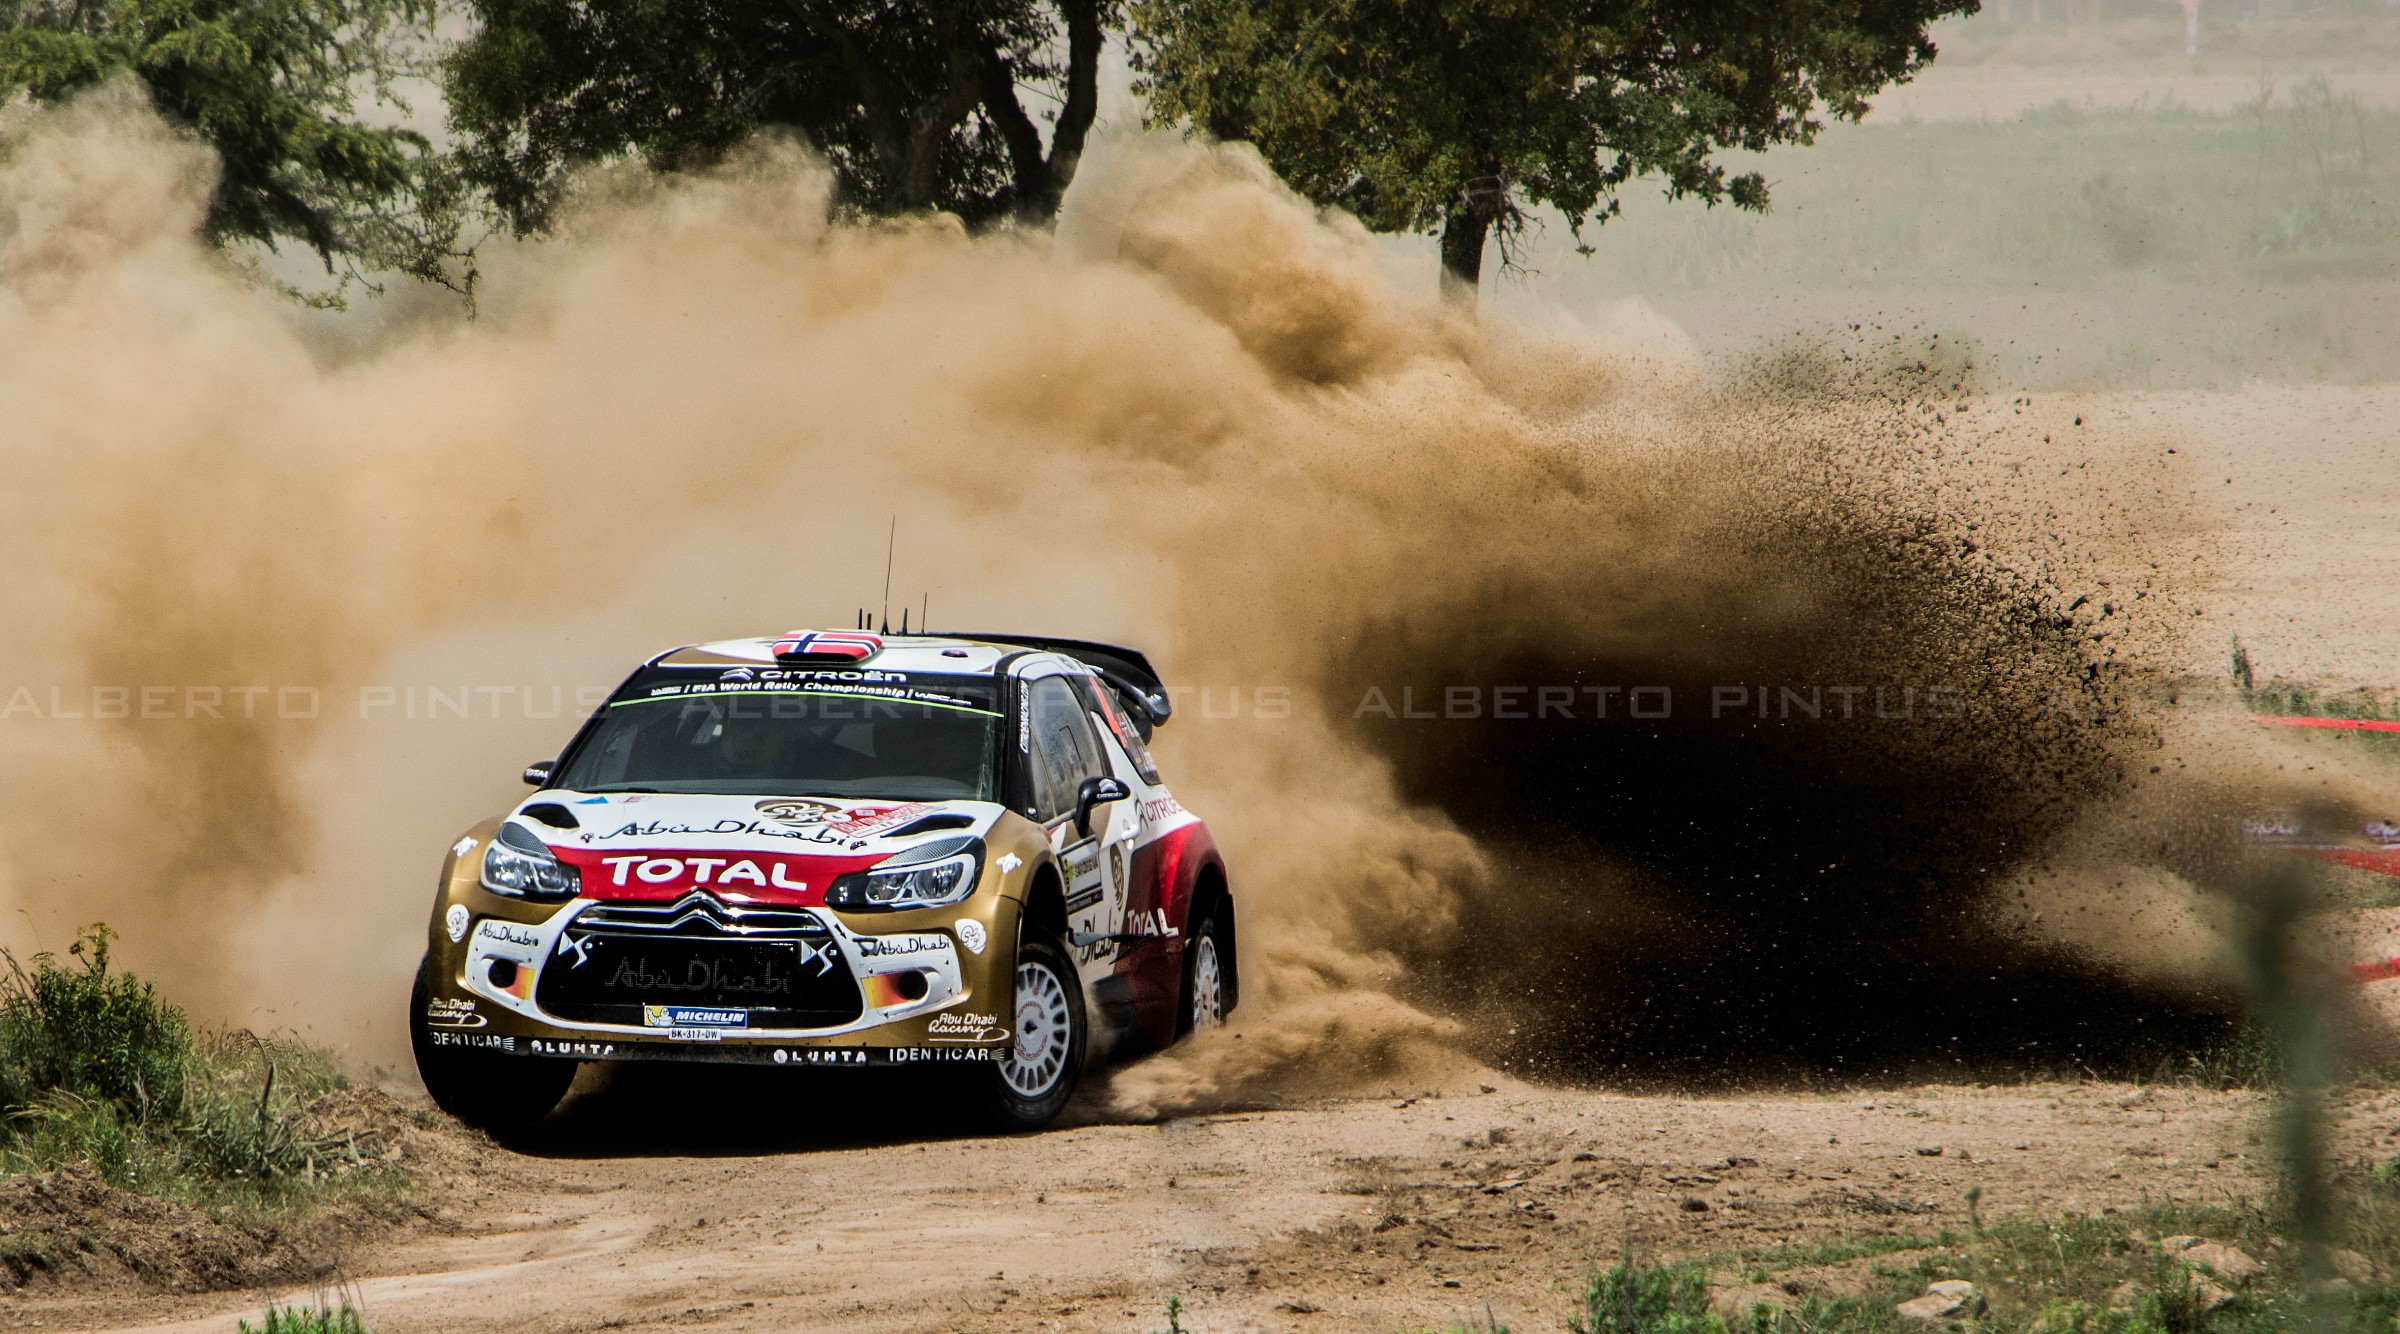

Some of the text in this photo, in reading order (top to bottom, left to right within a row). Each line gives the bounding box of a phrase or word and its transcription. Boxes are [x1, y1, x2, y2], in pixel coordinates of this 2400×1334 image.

[692, 683, 716, 693] FIA
[720, 682, 761, 692] World
[764, 681, 800, 691] Rally
[804, 682, 906, 698] Championship
[601, 855, 808, 891] TOTAL
[1127, 907, 1180, 938] TOTAL
[448, 998, 476, 1011] Dhabi
[675, 1011, 745, 1022] MICHELIN
[939, 1012, 998, 1026] Abu Dhabi
[671, 1029, 718, 1039] BK-317-DW
[928, 1020, 995, 1041] Racing
[430, 1031, 502, 1049] DENTICAR
[545, 1041, 614, 1056] LUHTA
[889, 1047, 989, 1062] IDENTICAR
[792, 1050, 867, 1063] LUHTA
